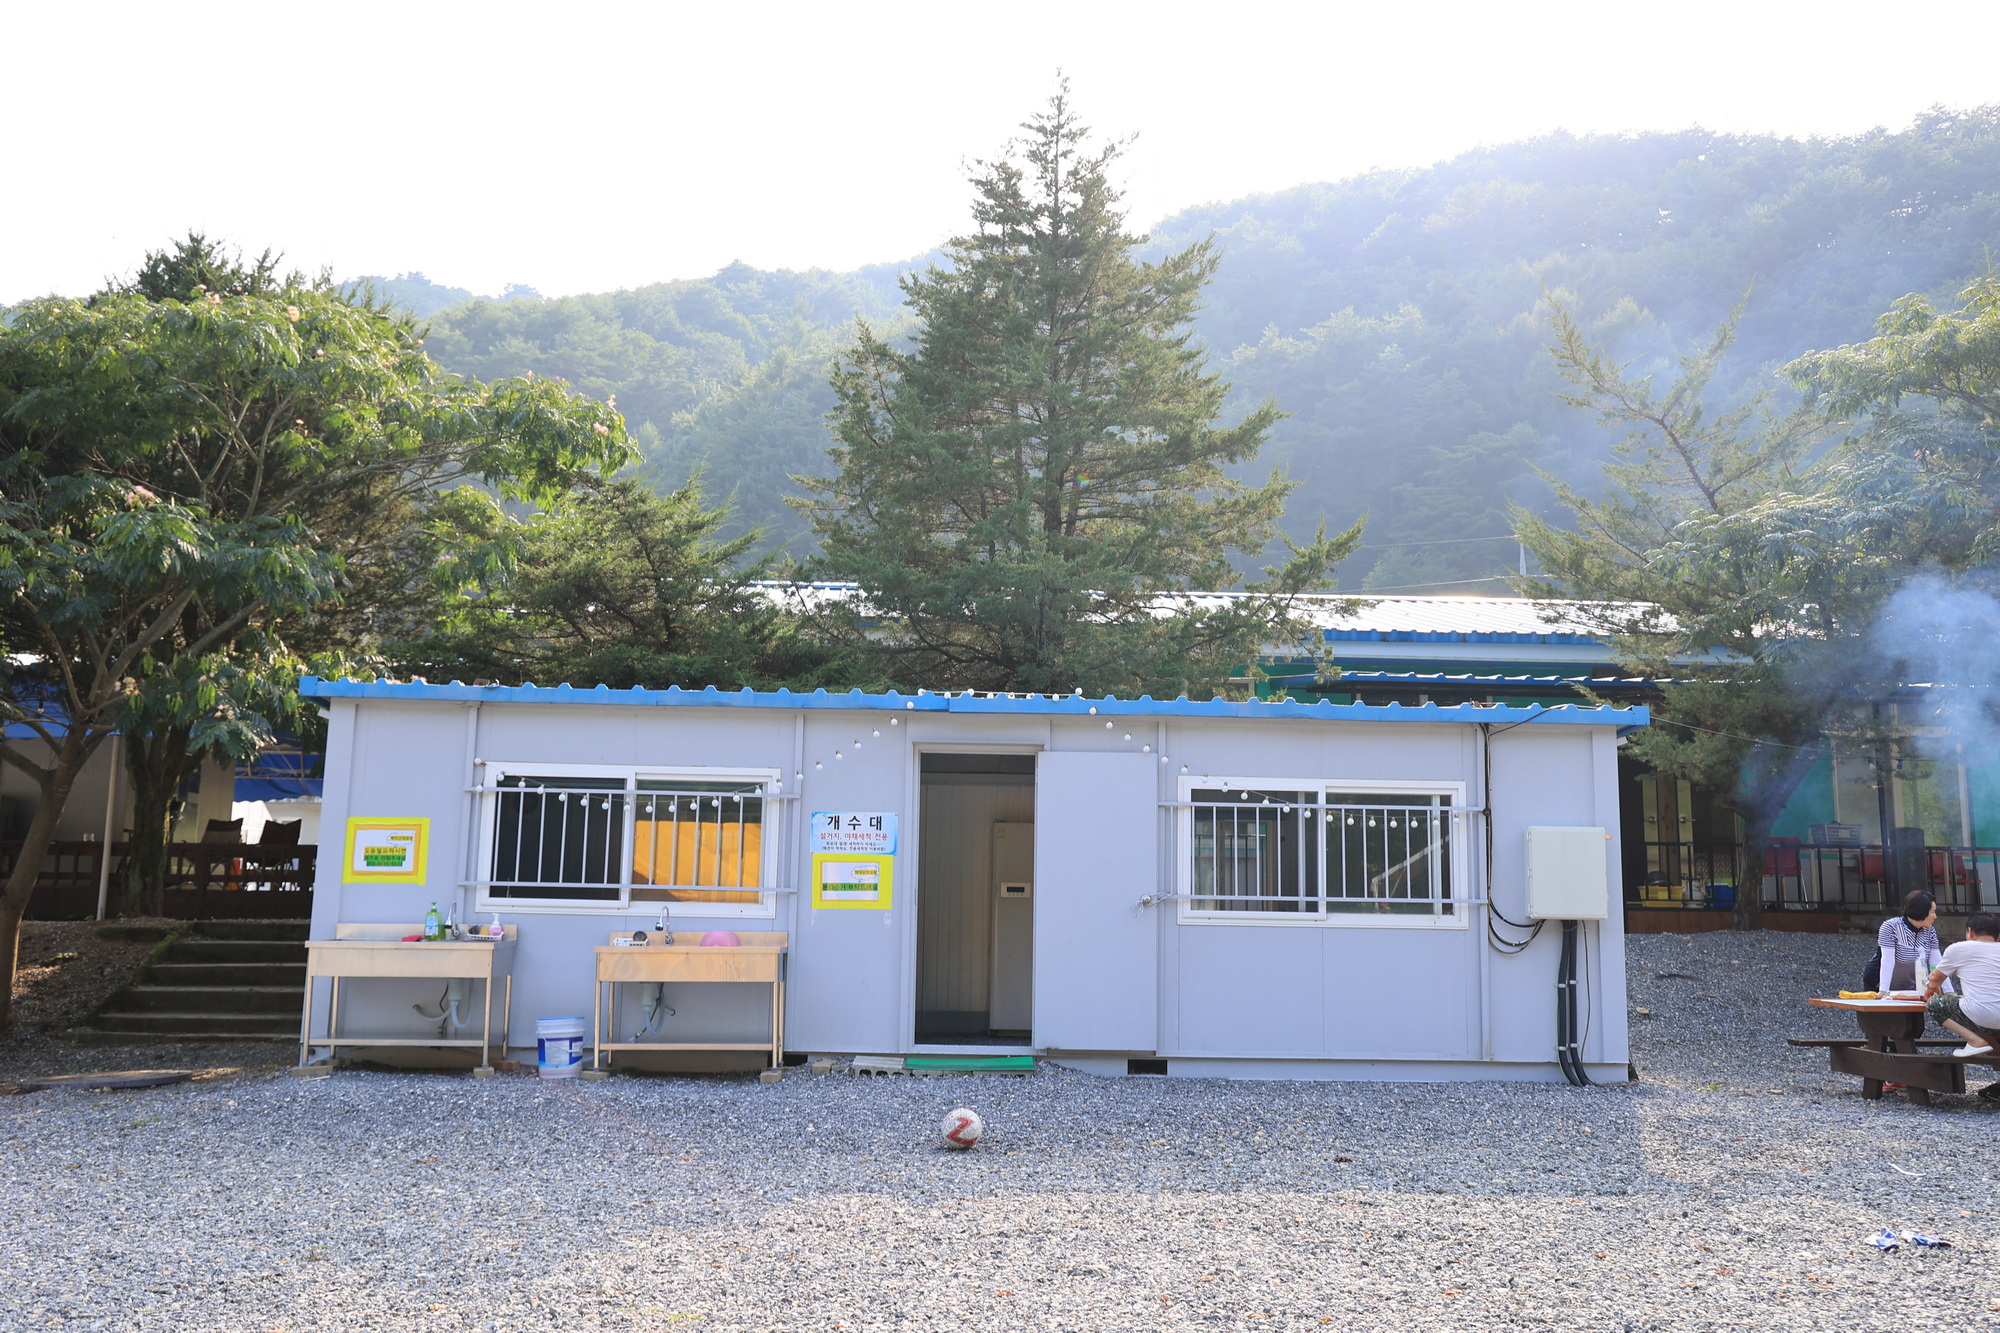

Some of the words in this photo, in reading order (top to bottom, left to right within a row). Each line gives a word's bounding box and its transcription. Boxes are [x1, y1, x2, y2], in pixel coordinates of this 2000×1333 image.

[827, 815, 840, 830] 개
[848, 815, 861, 831] 수
[870, 815, 882, 831] 대
[844, 833, 872, 841] 야채세척
[874, 833, 888, 841] 전용
